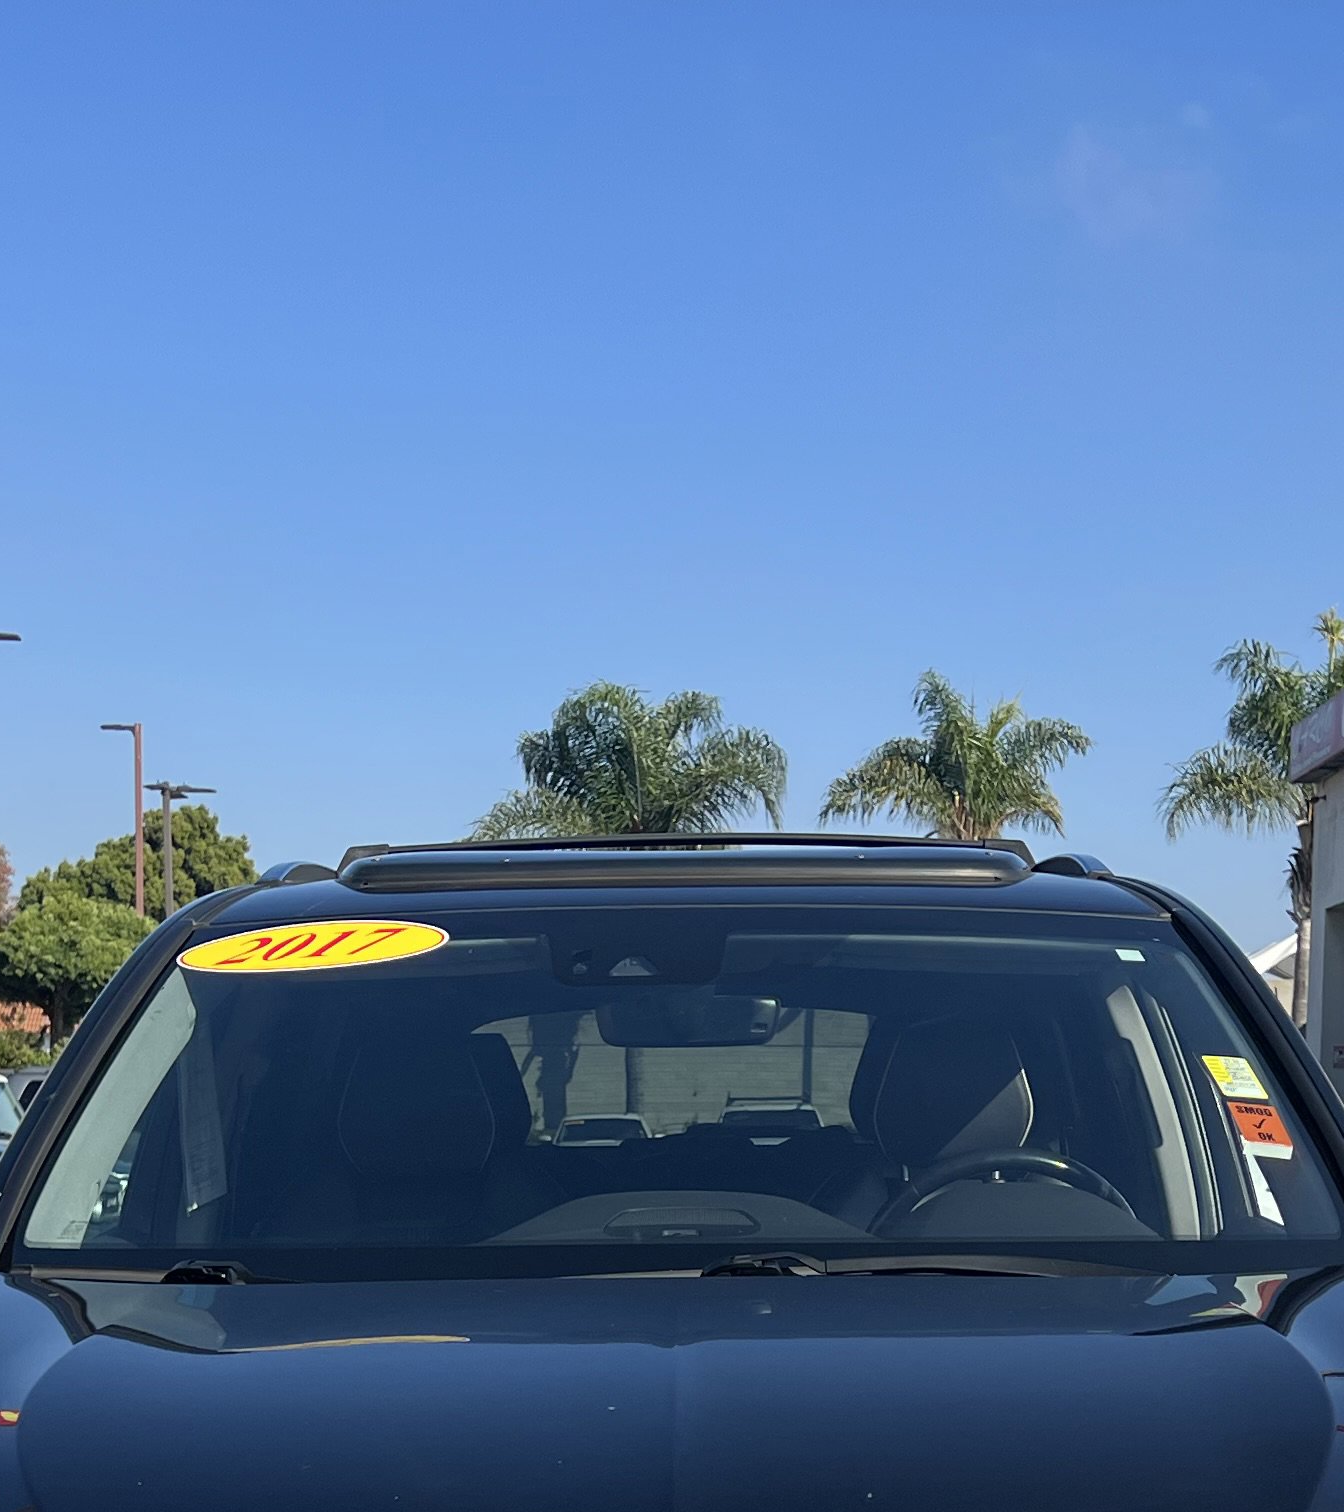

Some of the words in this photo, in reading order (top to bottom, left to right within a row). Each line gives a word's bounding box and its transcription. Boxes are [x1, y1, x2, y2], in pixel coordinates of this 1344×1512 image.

[216, 928, 406, 965] 2017
[1235, 1105, 1273, 1117] SMOG
[1258, 1132, 1276, 1142] OK
